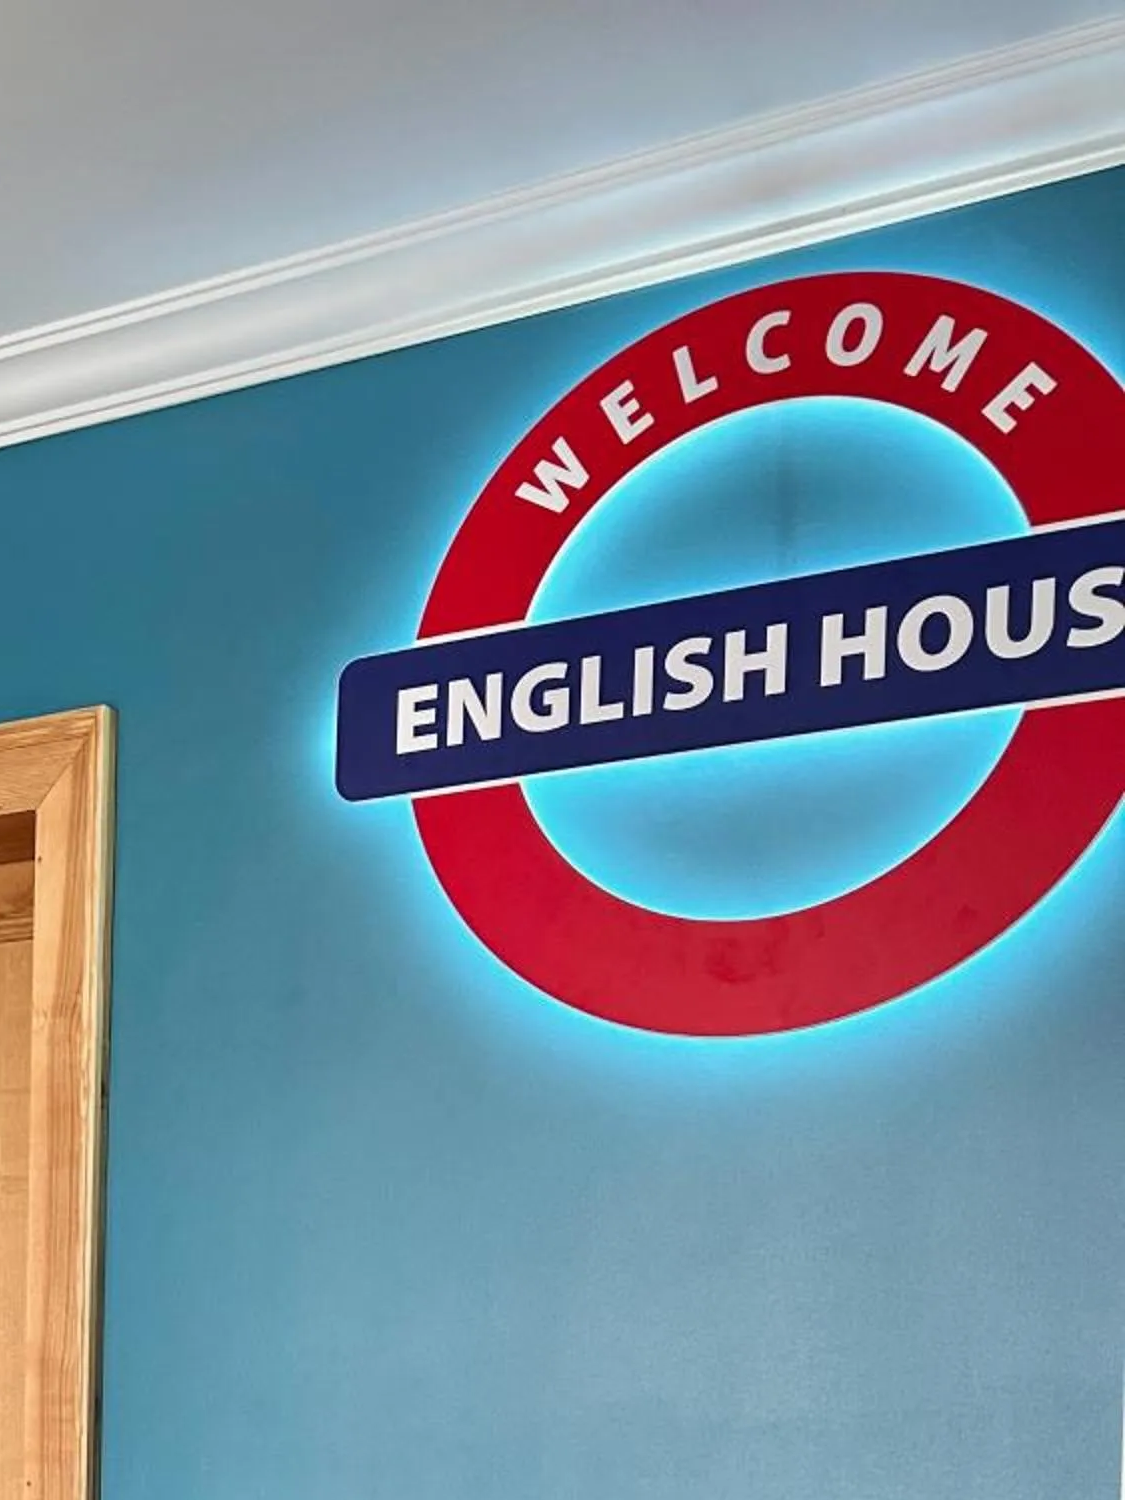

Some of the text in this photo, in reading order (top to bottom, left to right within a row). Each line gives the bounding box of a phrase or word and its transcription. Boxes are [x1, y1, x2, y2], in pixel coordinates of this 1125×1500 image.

[515, 301, 1057, 513] WELCOME
[395, 566, 1125, 756] ENGLISH HOUS
